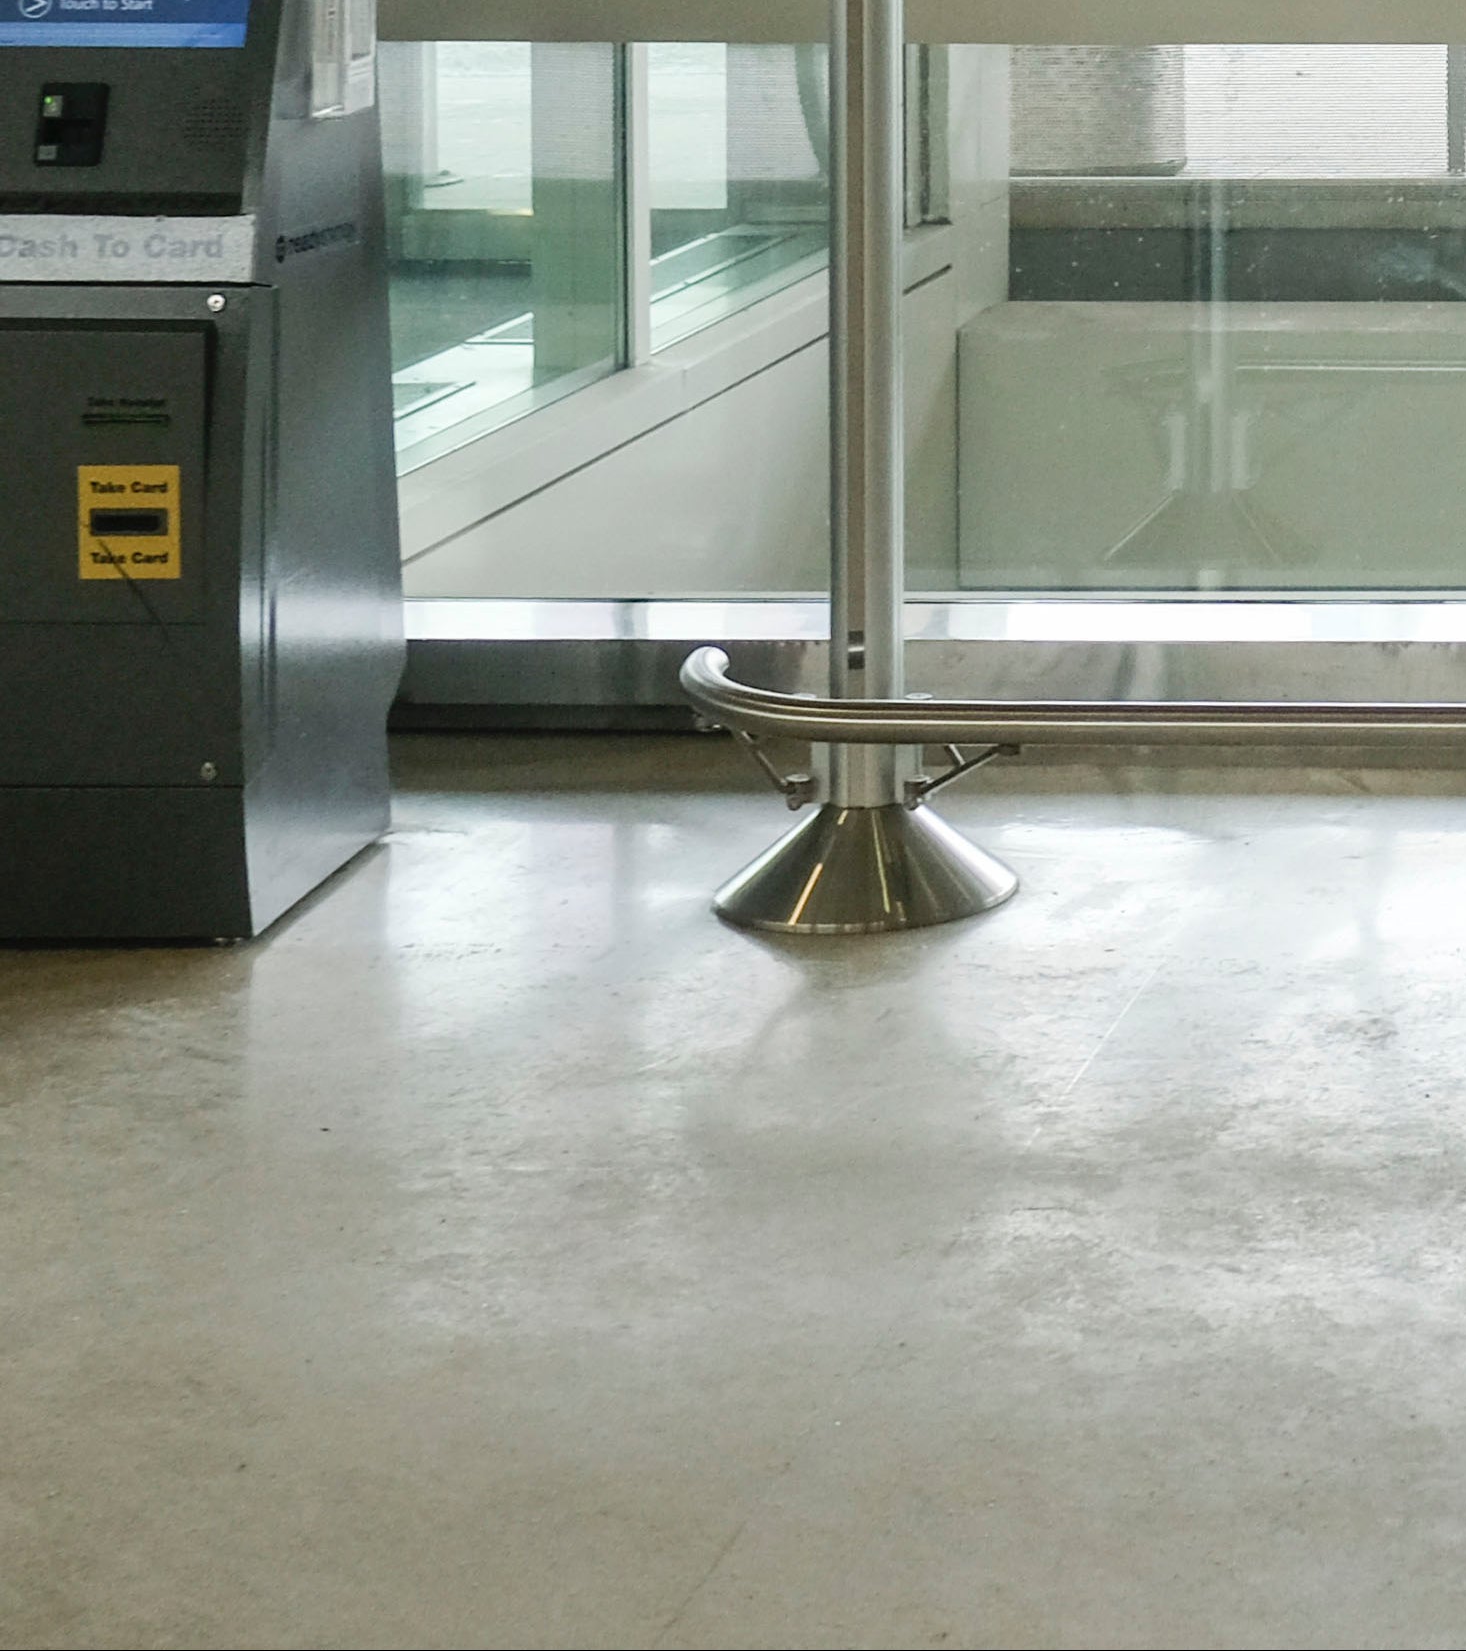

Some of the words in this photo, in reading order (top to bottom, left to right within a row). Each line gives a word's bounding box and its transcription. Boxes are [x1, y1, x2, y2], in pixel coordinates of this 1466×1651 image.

[103, 0, 118, 10] to
[93, 234, 129, 258] To
[144, 235, 222, 259] Card
[90, 481, 126, 493] Take
[131, 481, 168, 493] Card
[90, 552, 127, 564] Take
[132, 552, 168, 564] Card
